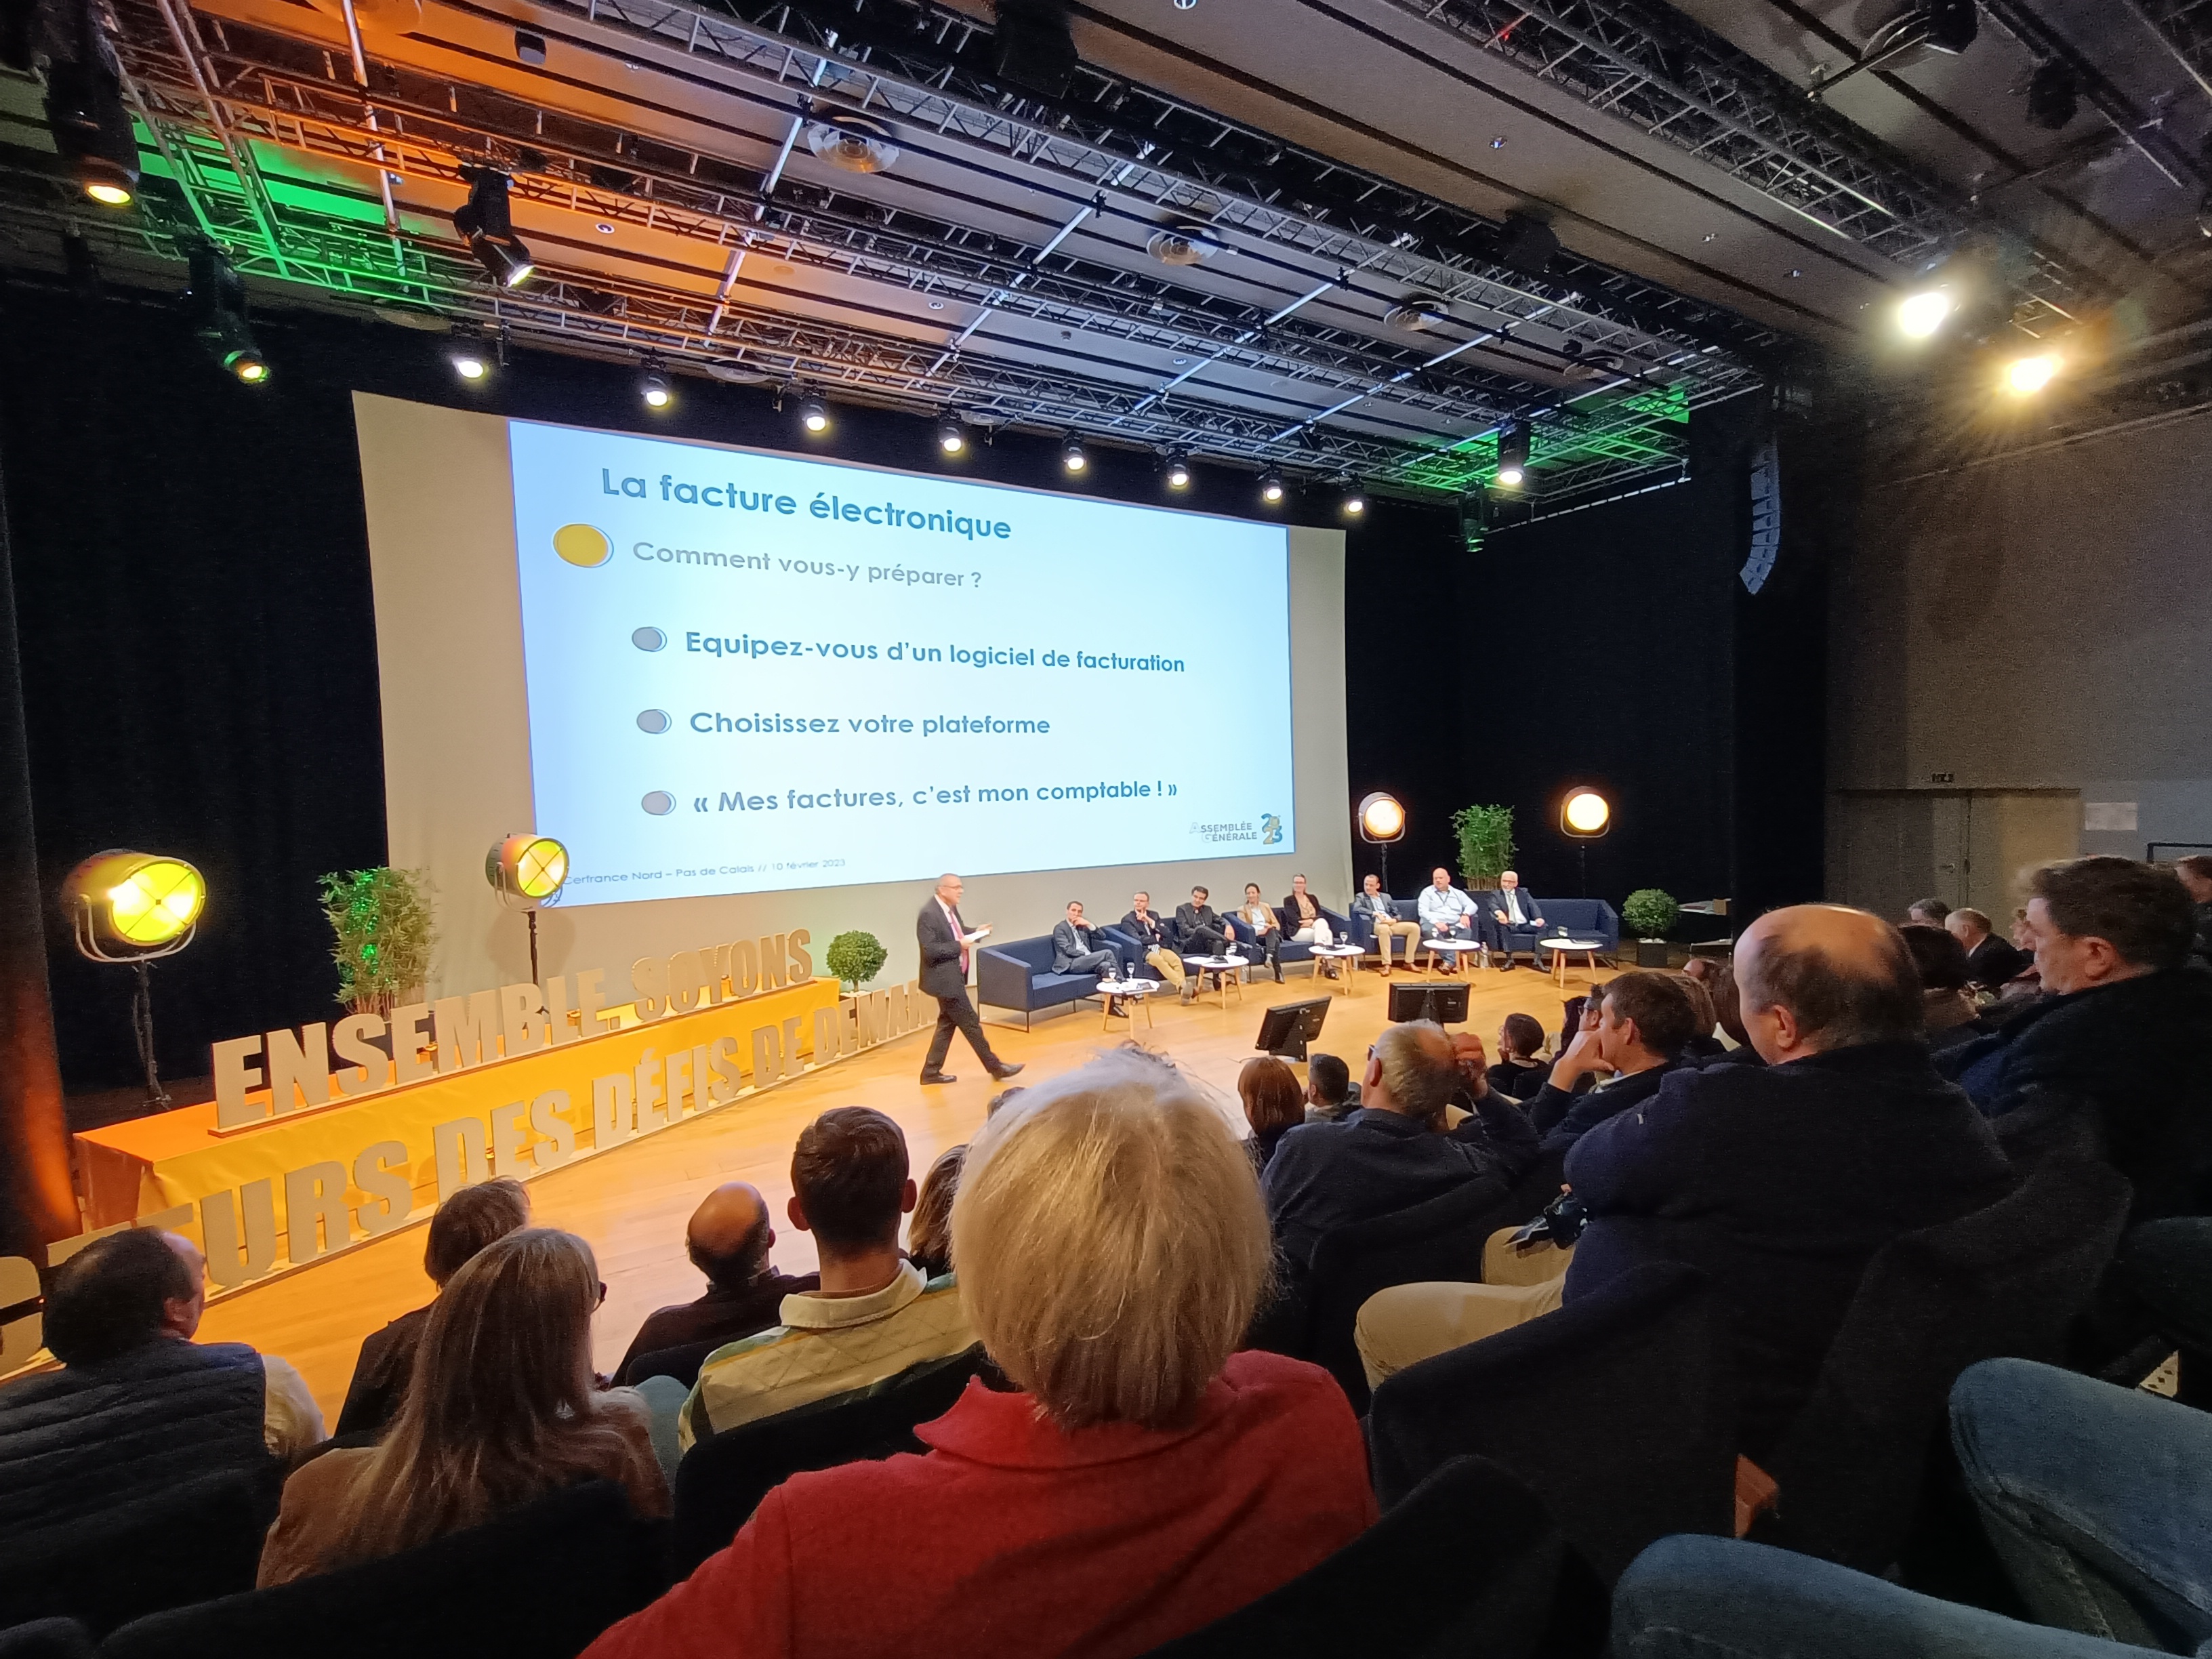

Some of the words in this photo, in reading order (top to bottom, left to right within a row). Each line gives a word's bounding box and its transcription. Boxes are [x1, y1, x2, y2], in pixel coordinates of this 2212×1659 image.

[602, 468, 646, 498] La
[659, 475, 796, 514] facture
[810, 492, 1012, 541] électronique
[633, 542, 771, 570] Comment
[778, 558, 859, 581] vous-y
[868, 564, 964, 586] préparer
[971, 572, 981, 588] ?
[687, 632, 878, 659] Equipez-vous
[888, 642, 941, 661] d'un
[950, 644, 1034, 668] logiciel
[1042, 650, 1070, 667] de
[1077, 651, 1184, 672] facturation
[691, 712, 840, 733] Choisissez
[848, 715, 914, 733] votre
[923, 715, 1050, 737] plateforme
[718, 792, 778, 811] Mes
[787, 789, 903, 808] factures,
[913, 785, 970, 804] c'est
[979, 788, 1028, 802] mon
[1037, 781, 1151, 802] comptable
[565, 874, 628, 885] Cerfrance
[632, 871, 662, 880] Nord
[676, 869, 696, 877] Pas
[719, 865, 754, 874] Calais
[786, 861, 819, 869] février
[823, 859, 846, 868] 2023
[632, 929, 813, 1021] SOYONS
[434, 1089, 575, 1205] DES
[592, 1038, 742, 1150] DÉFIS
[751, 1016, 804, 1088] DE
